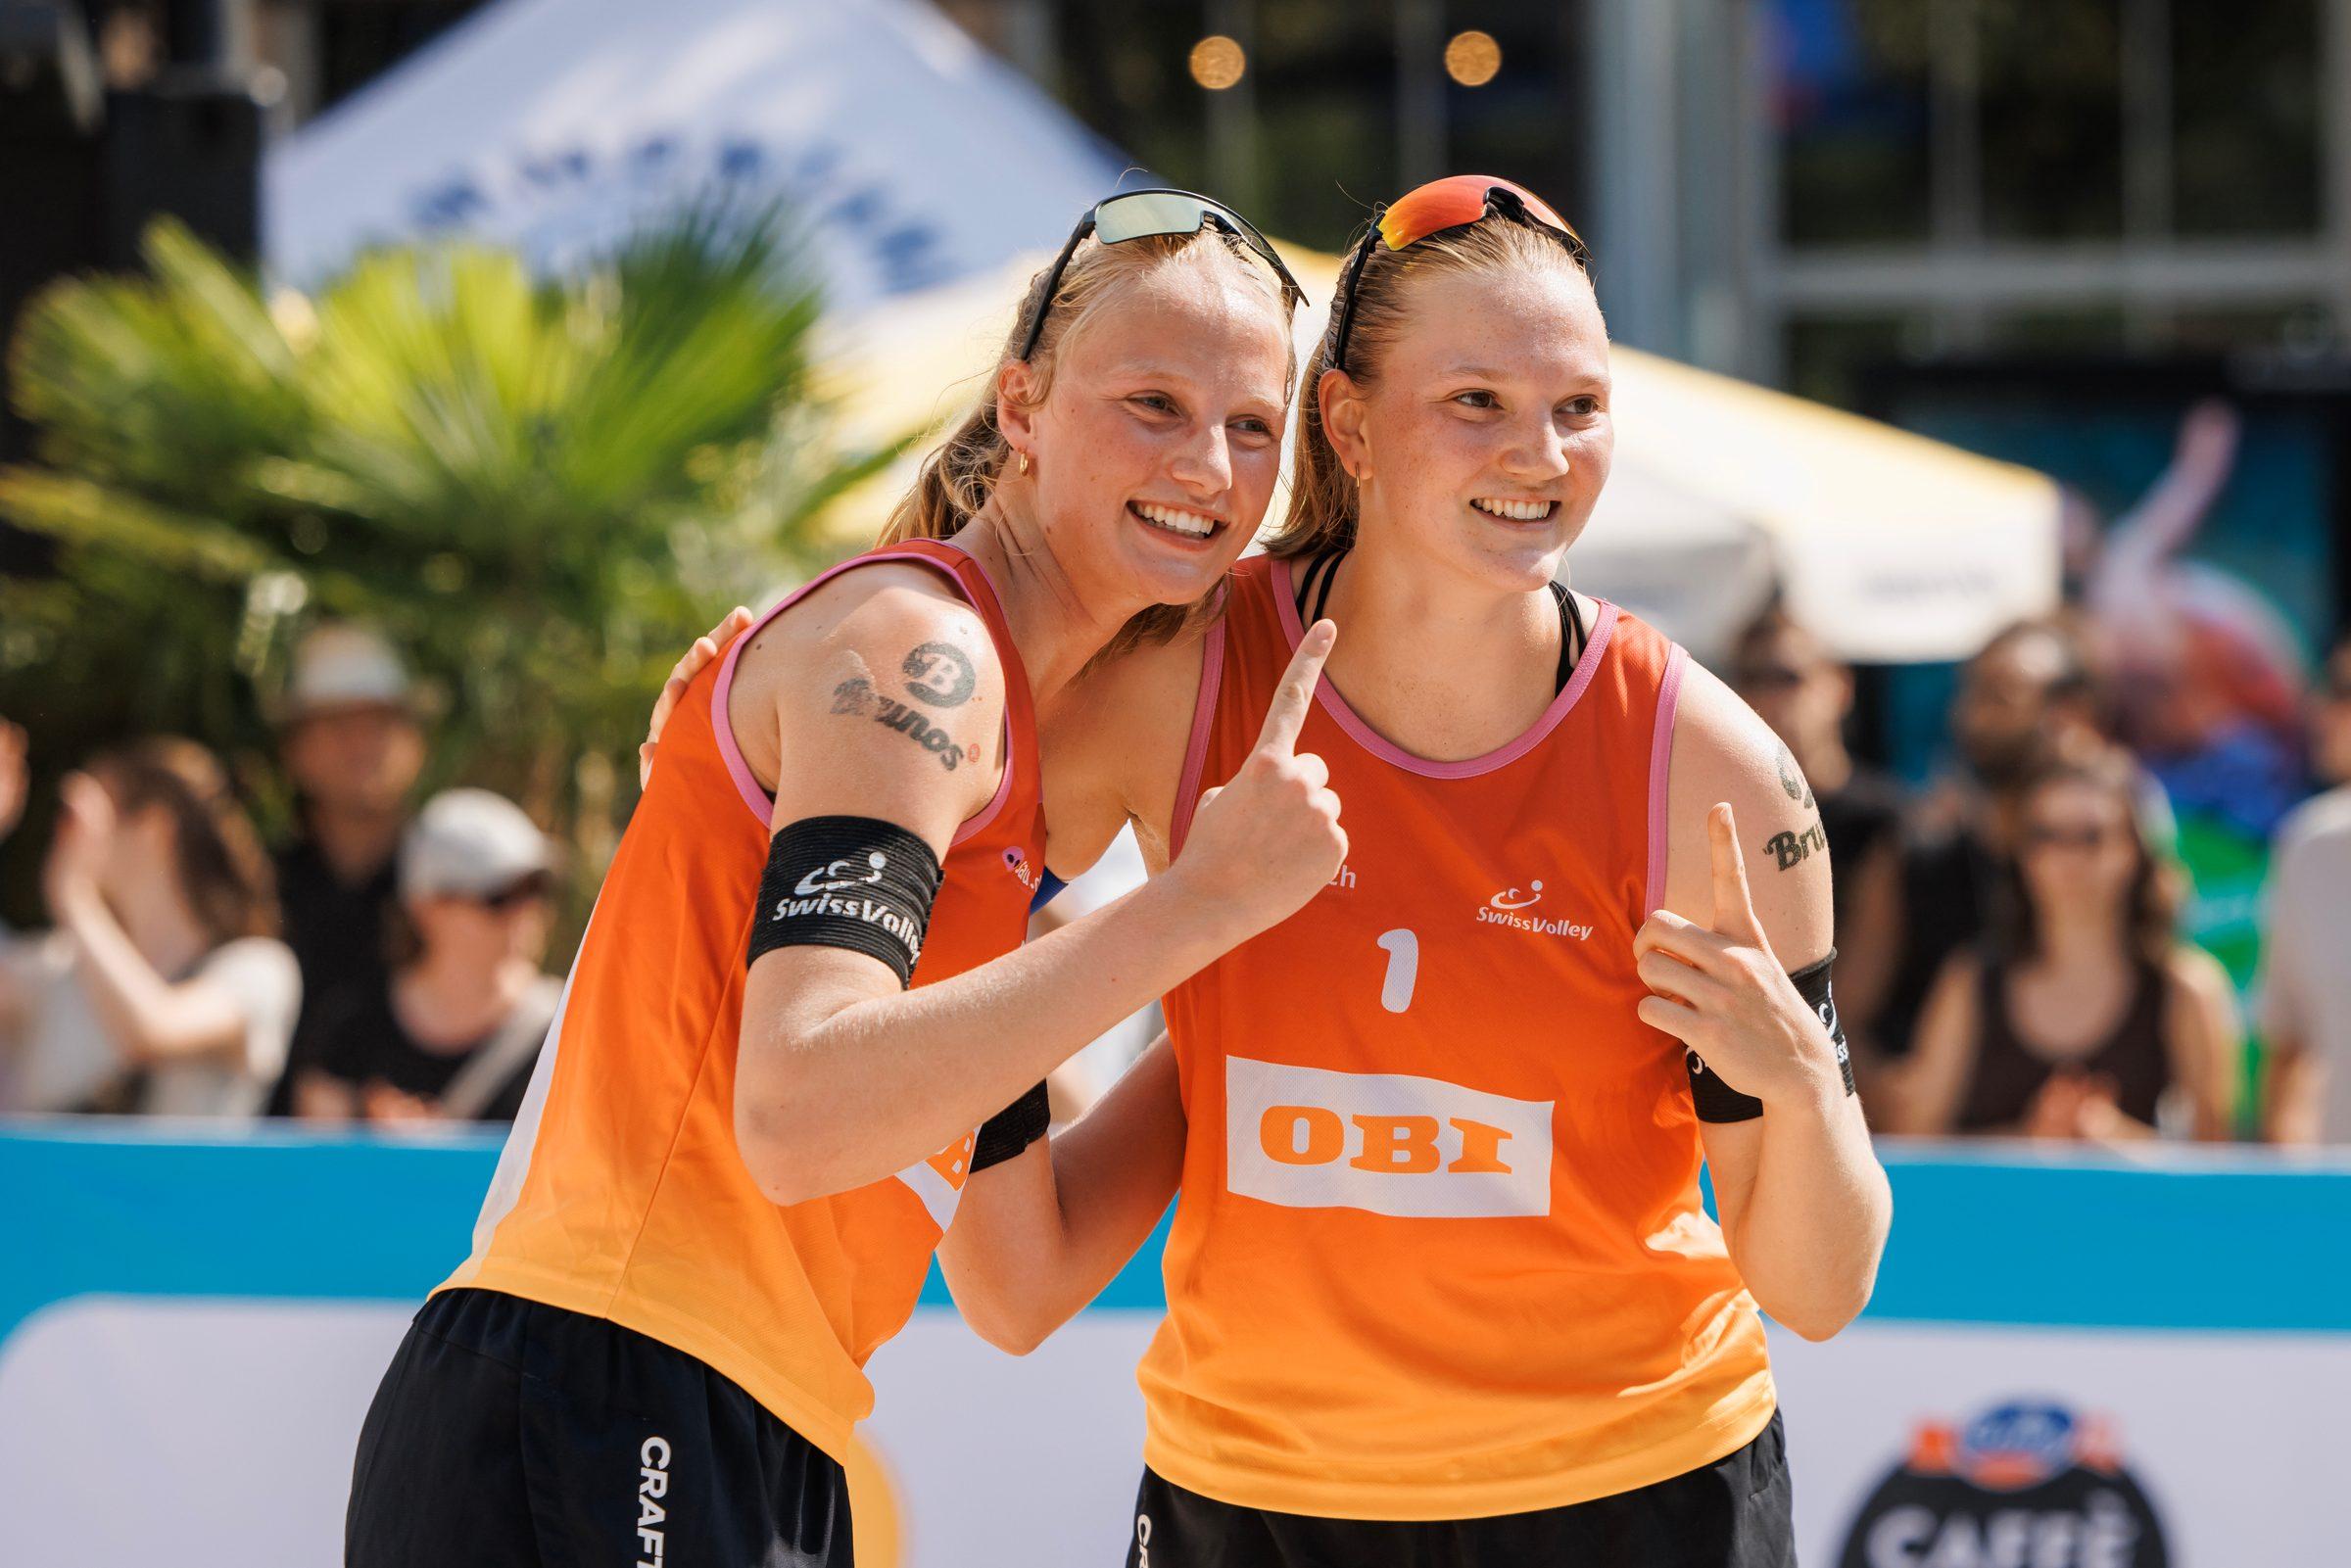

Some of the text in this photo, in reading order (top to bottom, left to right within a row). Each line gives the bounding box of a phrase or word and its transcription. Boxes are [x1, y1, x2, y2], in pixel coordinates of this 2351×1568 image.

[1762, 821, 1825, 872] Bru
[1476, 906, 1594, 940] SwissVolley
[1376, 928, 1419, 1014] 1
[1260, 1105, 1513, 1175] OBI
